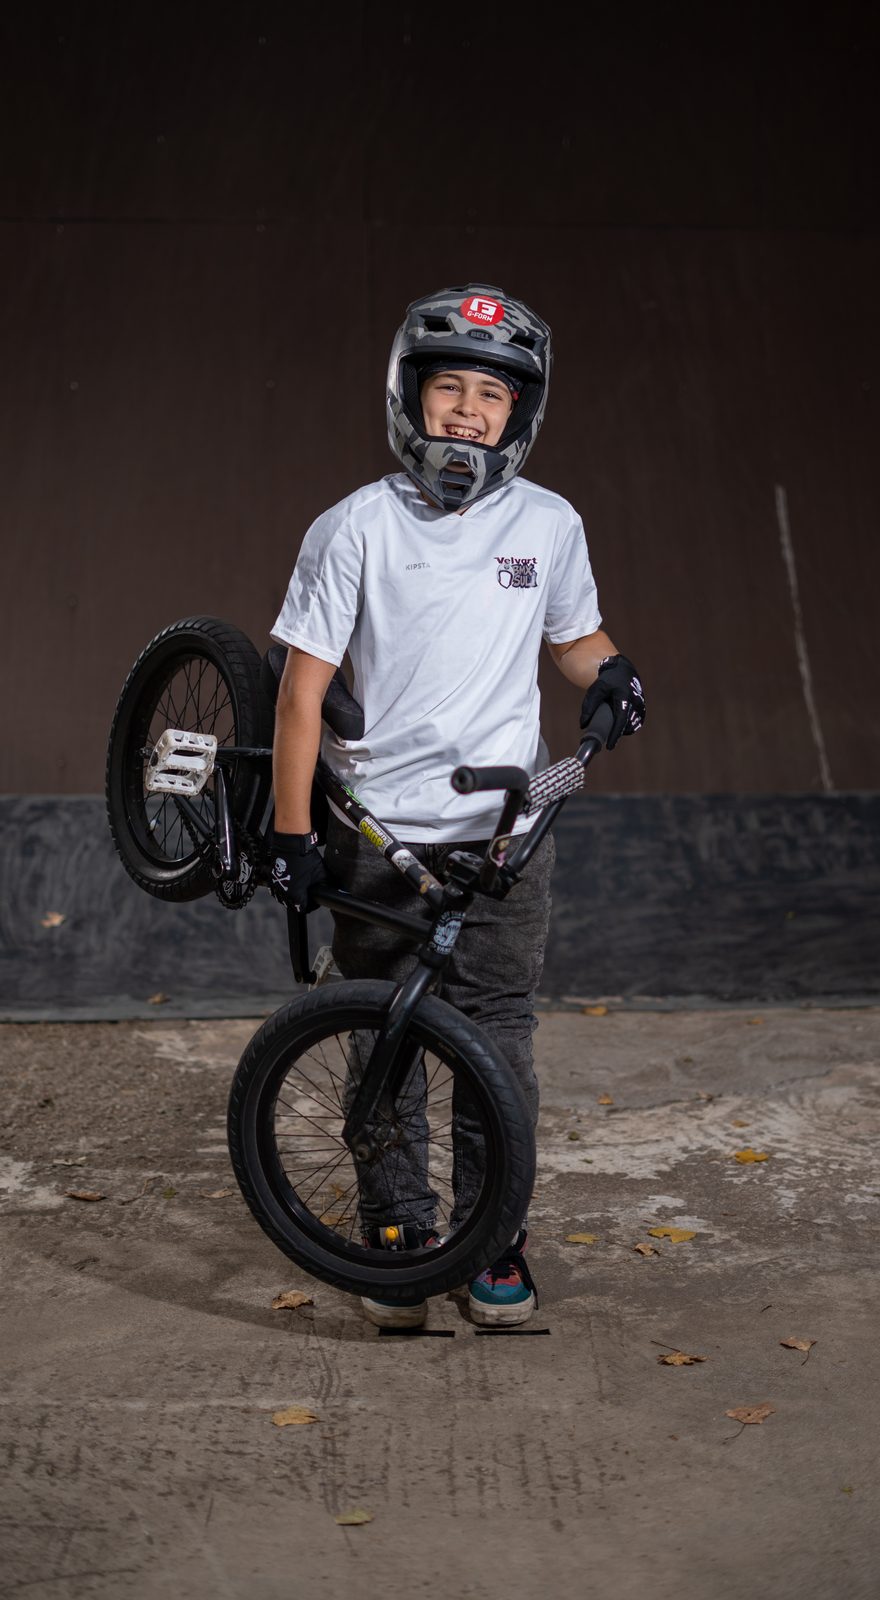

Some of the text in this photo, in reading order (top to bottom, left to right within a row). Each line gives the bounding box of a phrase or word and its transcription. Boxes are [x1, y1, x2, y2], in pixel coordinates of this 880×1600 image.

[467, 311, 492, 322] G-FORM
[470, 331, 490, 340] BELL
[405, 562, 430, 570] KIPSTA
[511, 564, 534, 576] BMX
